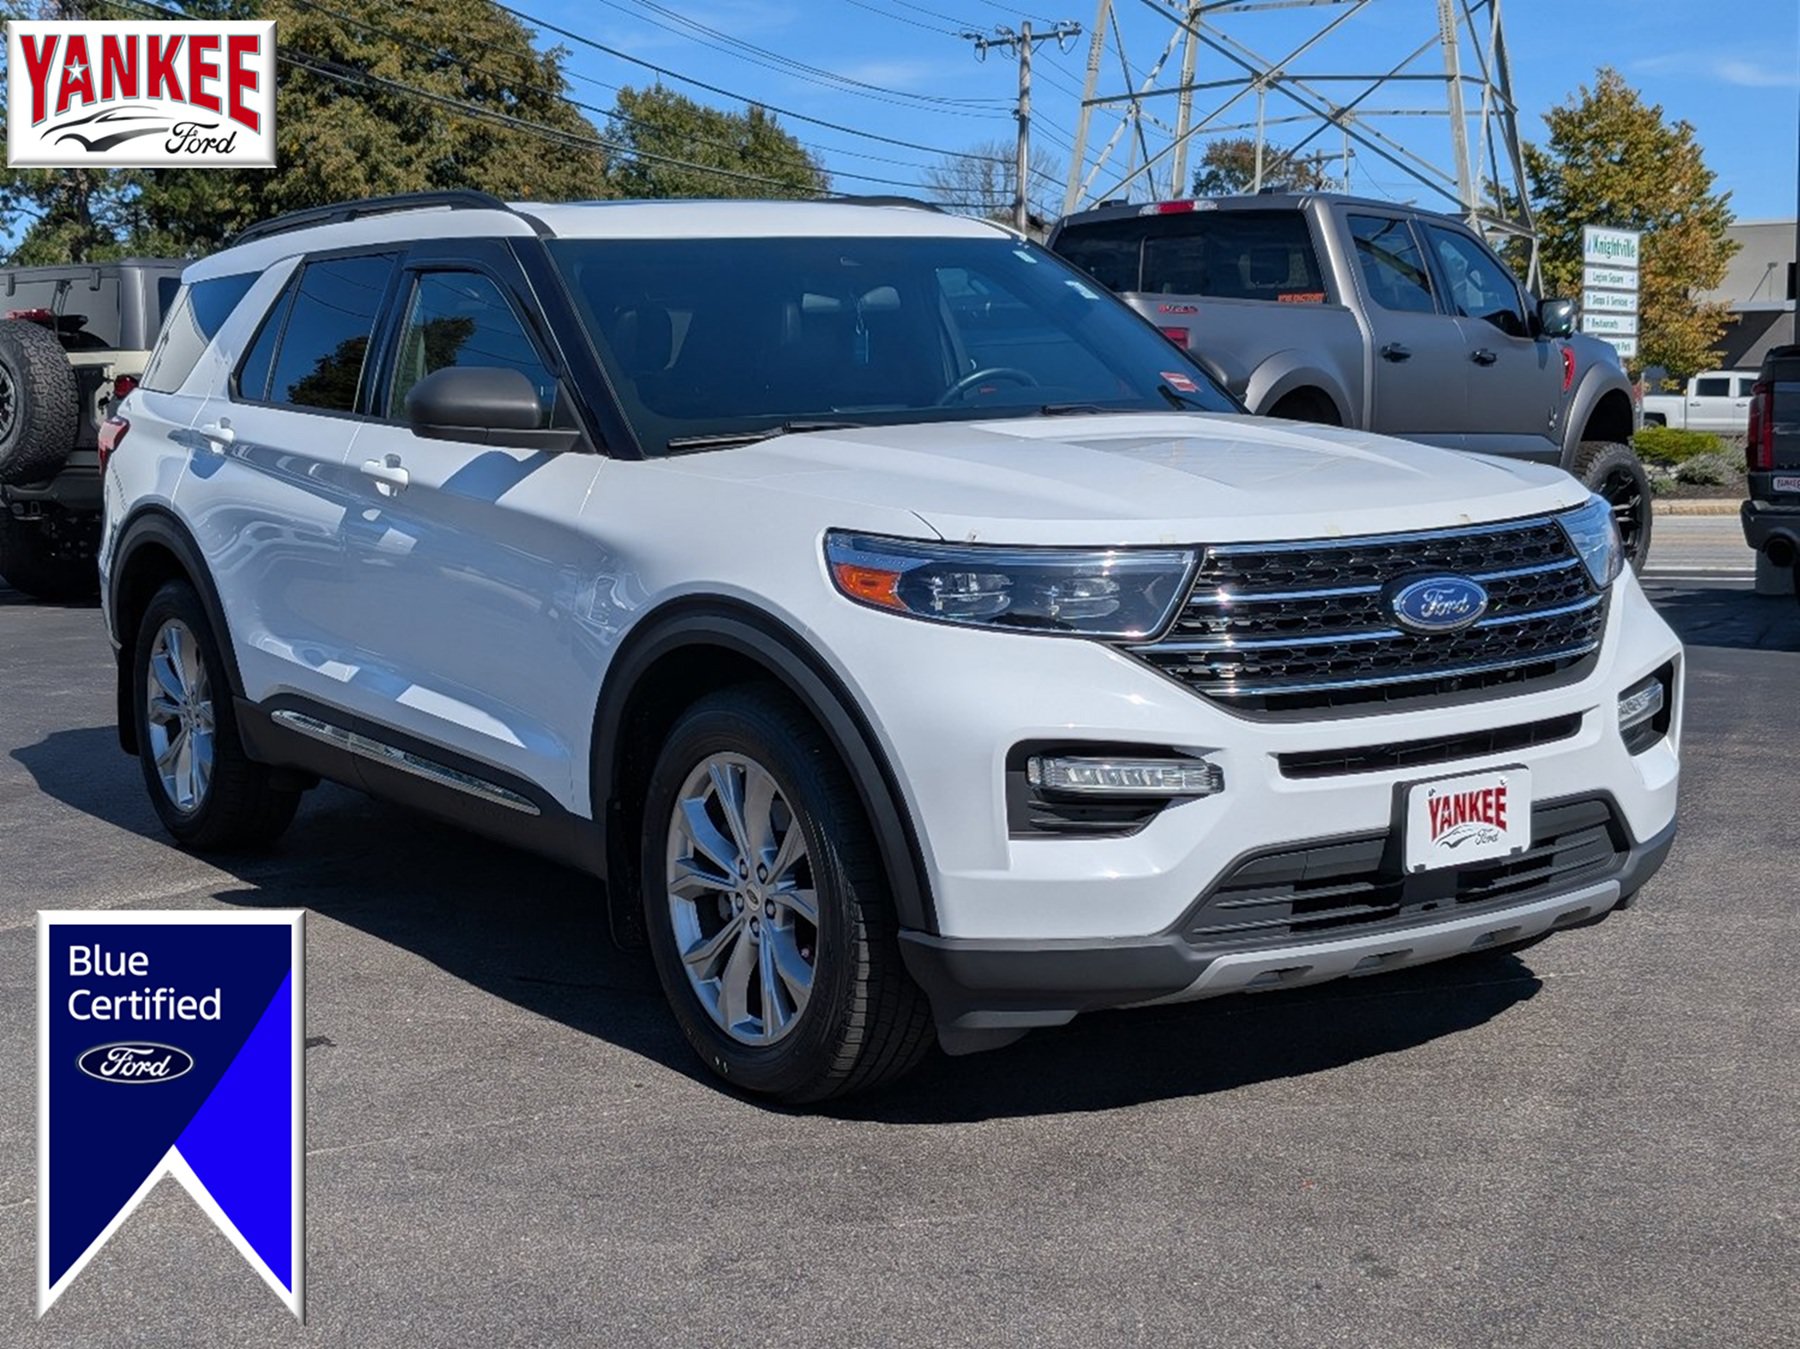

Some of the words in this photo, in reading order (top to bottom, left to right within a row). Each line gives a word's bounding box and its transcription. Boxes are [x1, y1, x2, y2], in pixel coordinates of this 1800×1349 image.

[1593, 234, 1635, 259] Knightville
[1421, 588, 1469, 617] Ford
[1428, 786, 1507, 842] YANKEE
[1475, 828, 1499, 846] Ford
